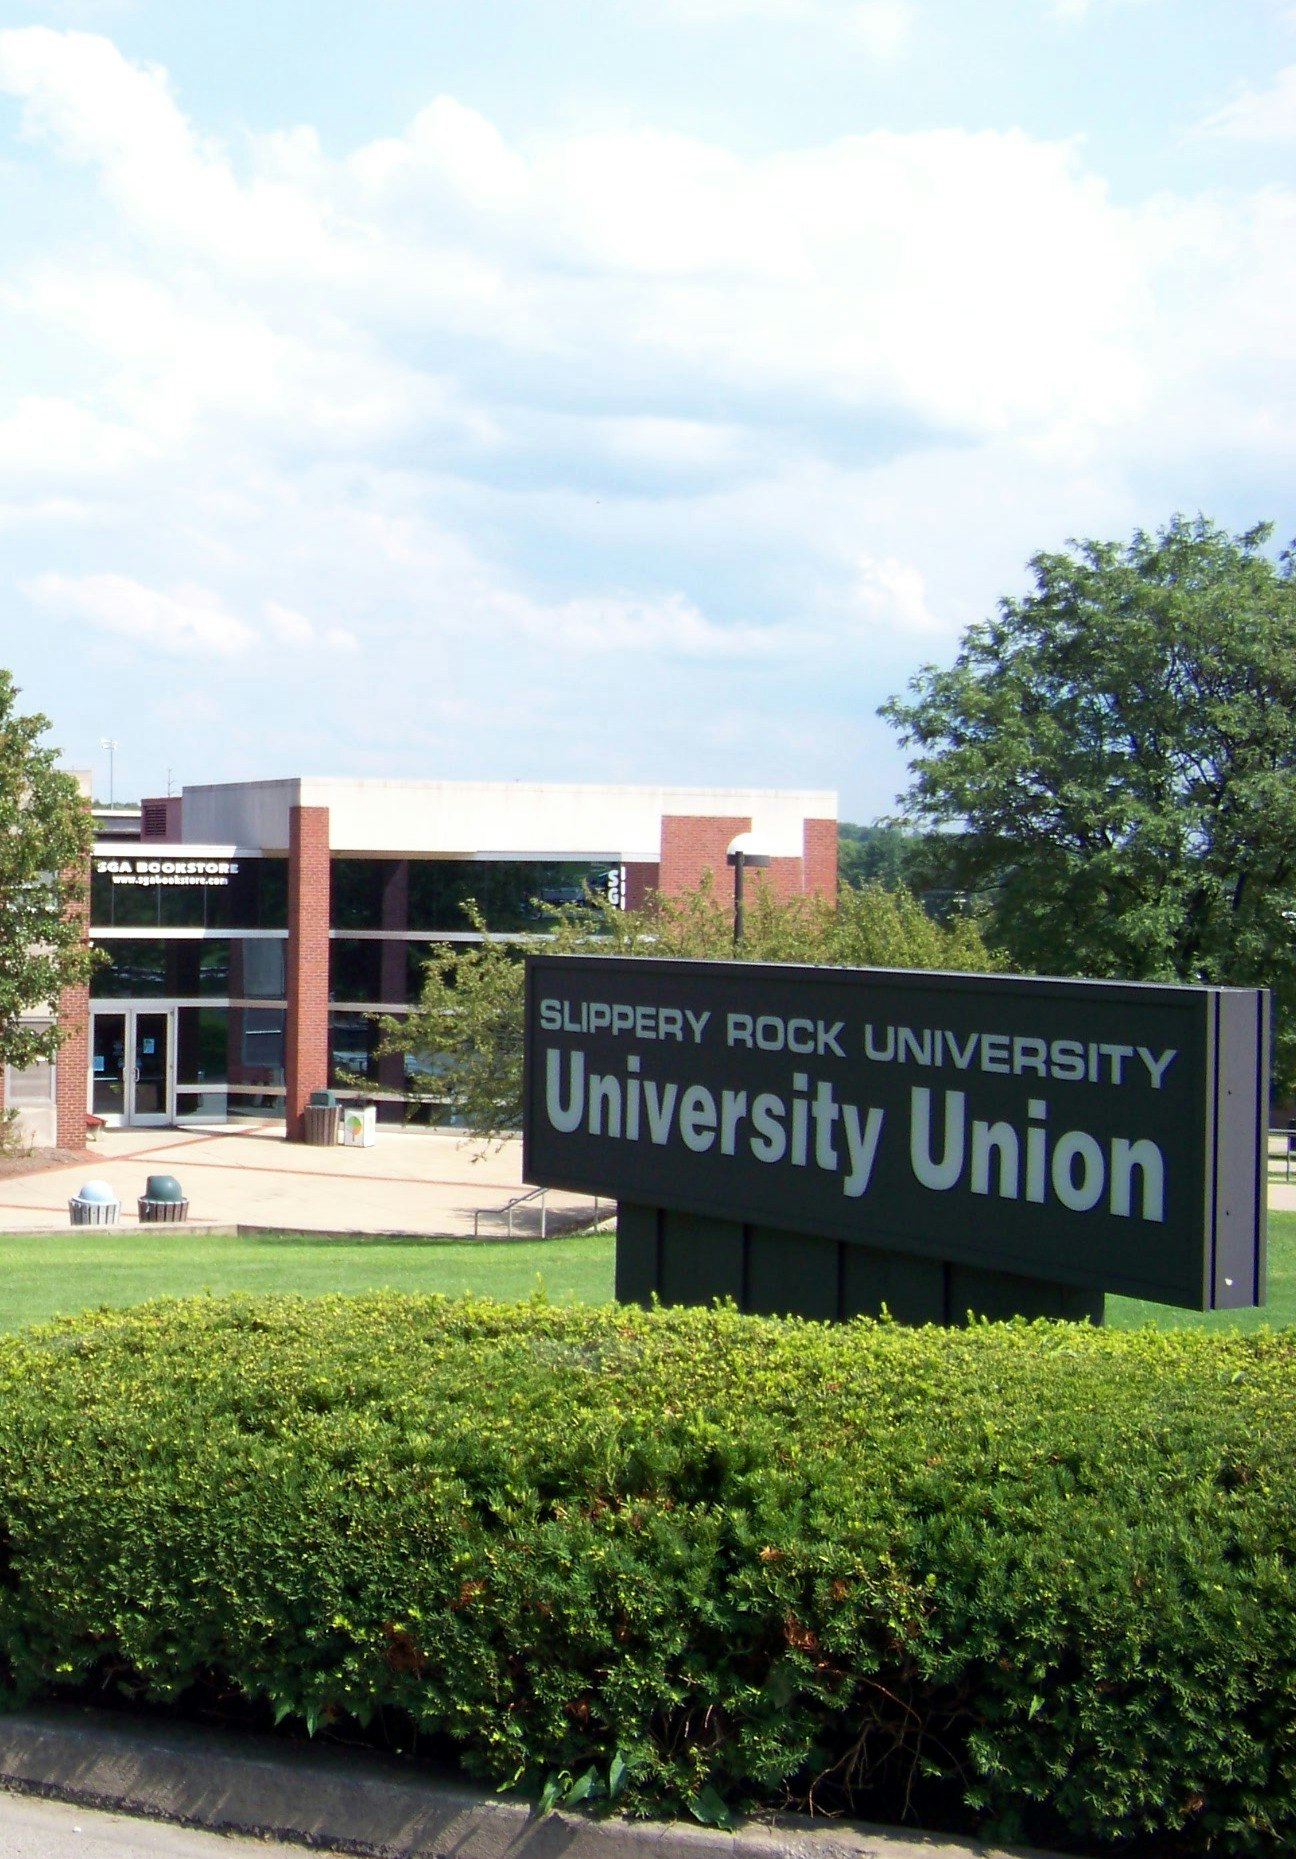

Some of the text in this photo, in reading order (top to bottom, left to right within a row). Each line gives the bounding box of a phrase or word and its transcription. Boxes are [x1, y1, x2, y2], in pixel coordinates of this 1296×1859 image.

[97, 861, 239, 874] SGA BOOKSTORE
[112, 875, 229, 886] www.sgabookstore.com
[540, 998, 1177, 1089] SLIPPERY ROCK UNIVERSITY
[546, 1048, 1165, 1223] University Union
